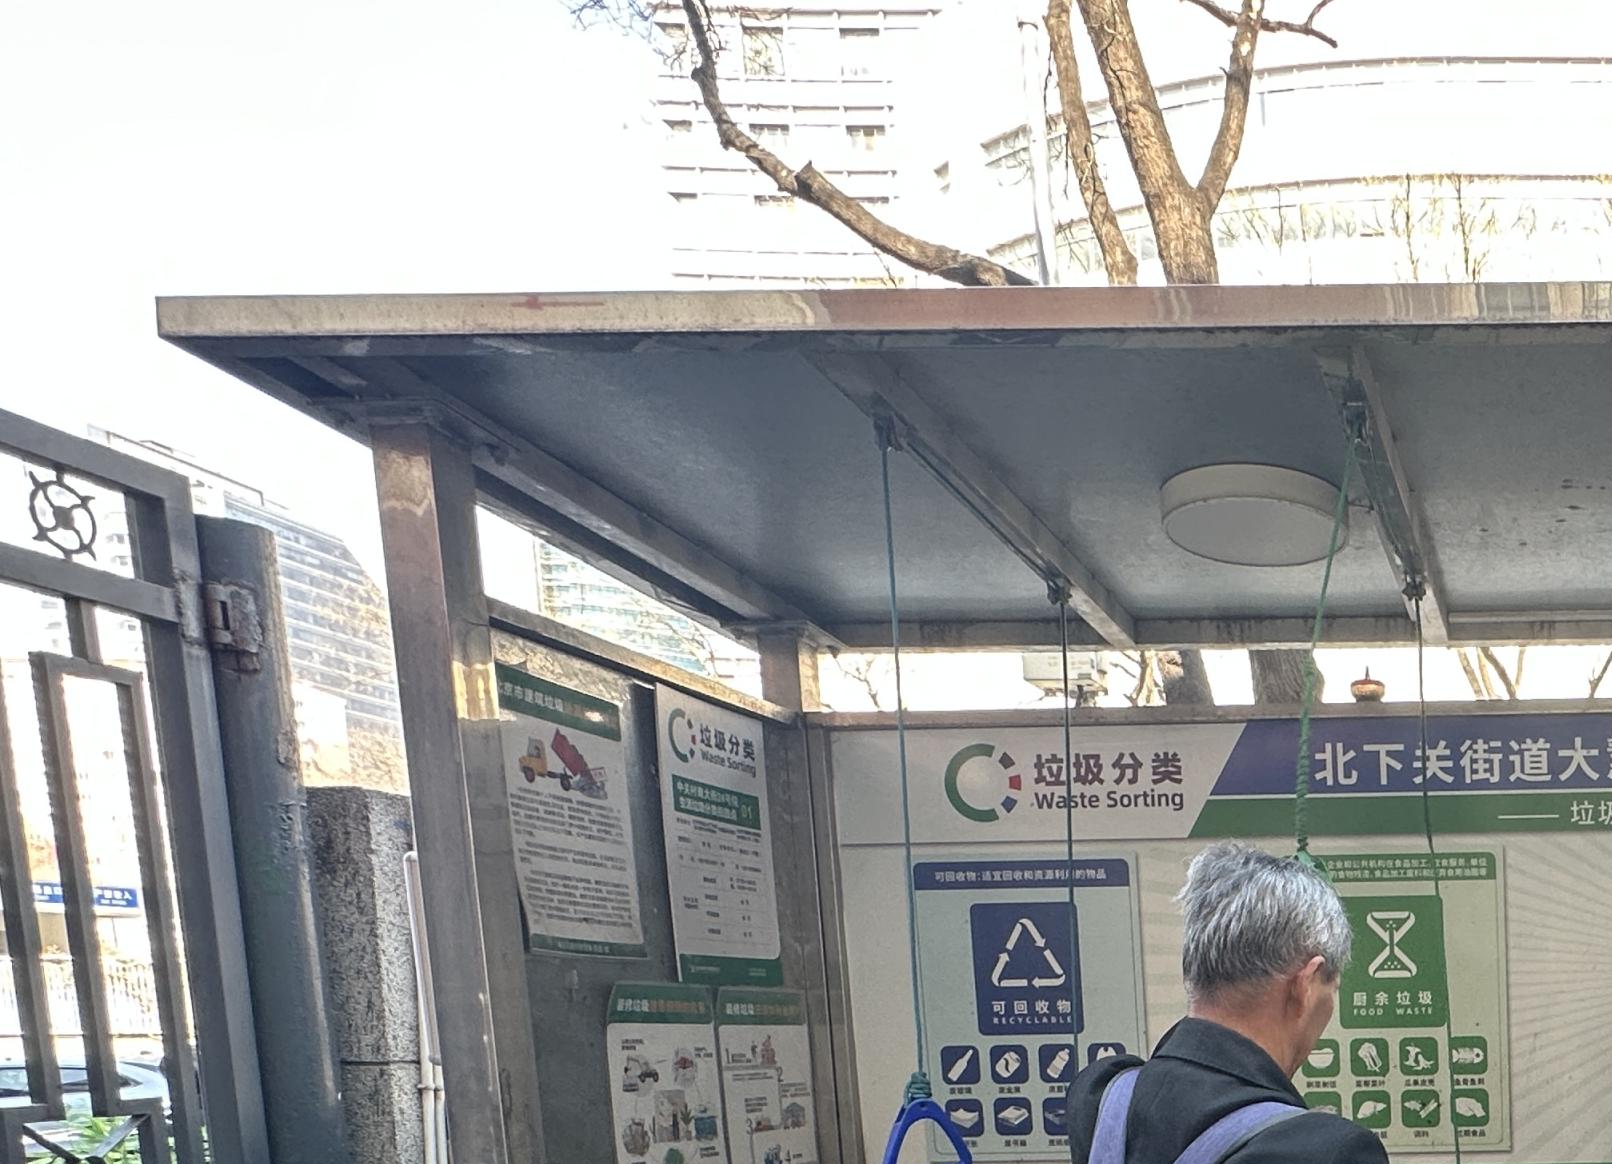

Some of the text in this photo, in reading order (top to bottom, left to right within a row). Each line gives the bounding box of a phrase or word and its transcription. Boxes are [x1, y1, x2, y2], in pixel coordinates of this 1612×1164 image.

[700, 724, 755, 761] 垃圾分类
[701, 750, 756, 778] Waste Sorting
[1034, 752, 1183, 786] 垃圾分类
[1034, 789, 1184, 811] Waste Sorting
[992, 1000, 1071, 1015] 可回收物
[1353, 991, 1432, 1006] 厨余垃圾
[1353, 1007, 1384, 1016] FOOD
